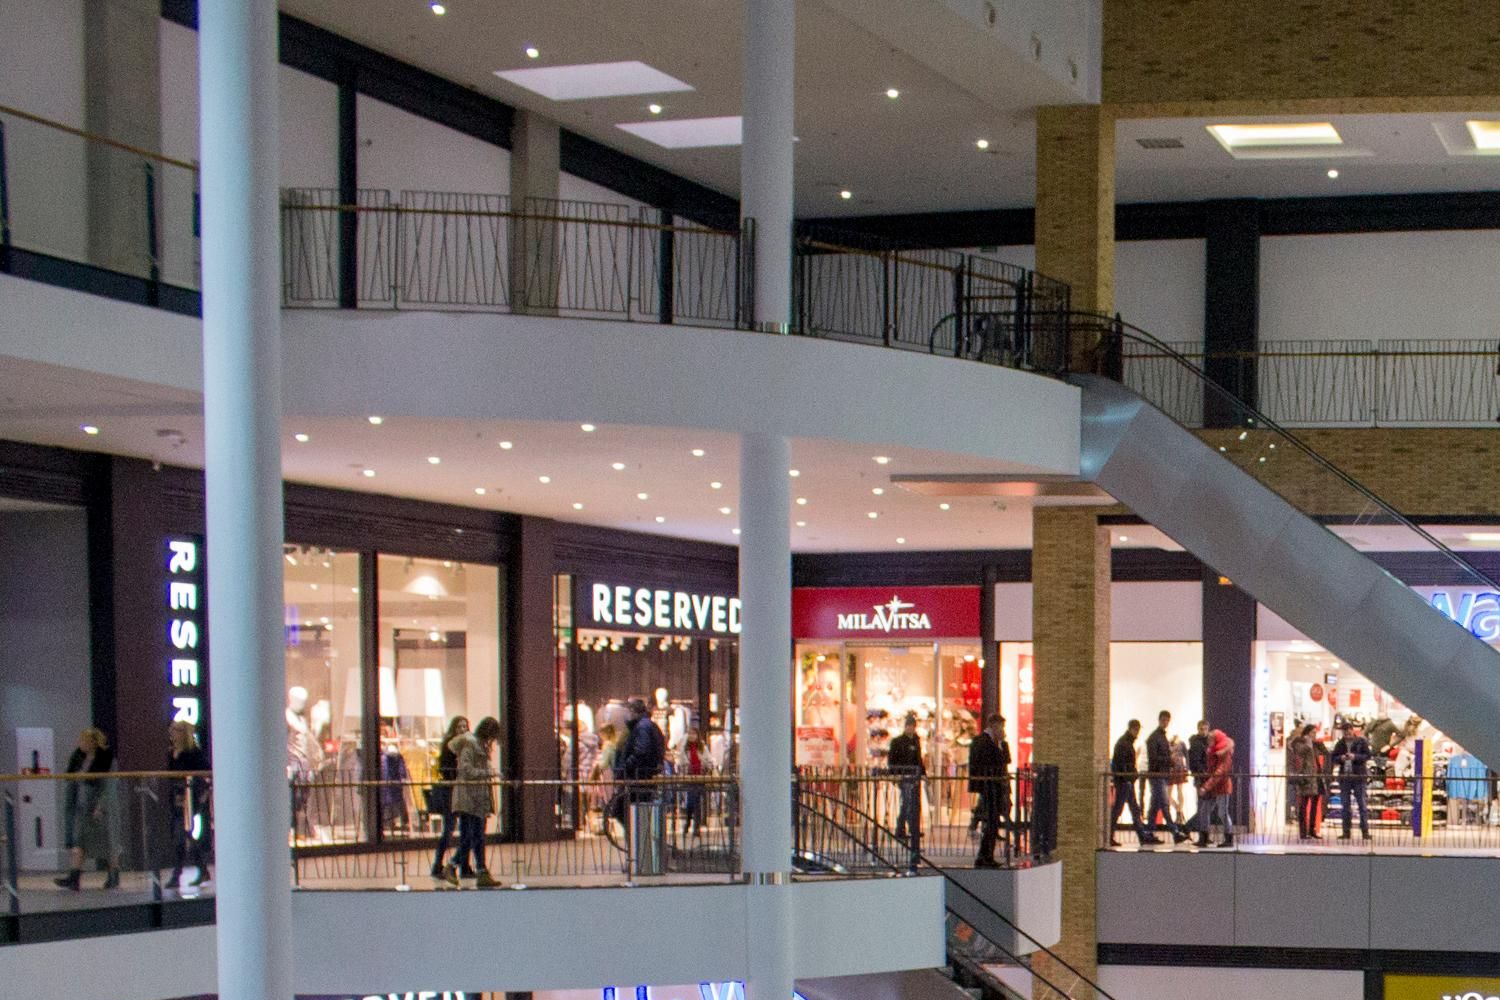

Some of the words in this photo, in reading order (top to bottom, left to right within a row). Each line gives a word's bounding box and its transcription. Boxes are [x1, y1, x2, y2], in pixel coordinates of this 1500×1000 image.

[592, 583, 742, 634] RESERVED
[837, 599, 931, 633] MILAVITSA
[169, 540, 199, 840] RESER
